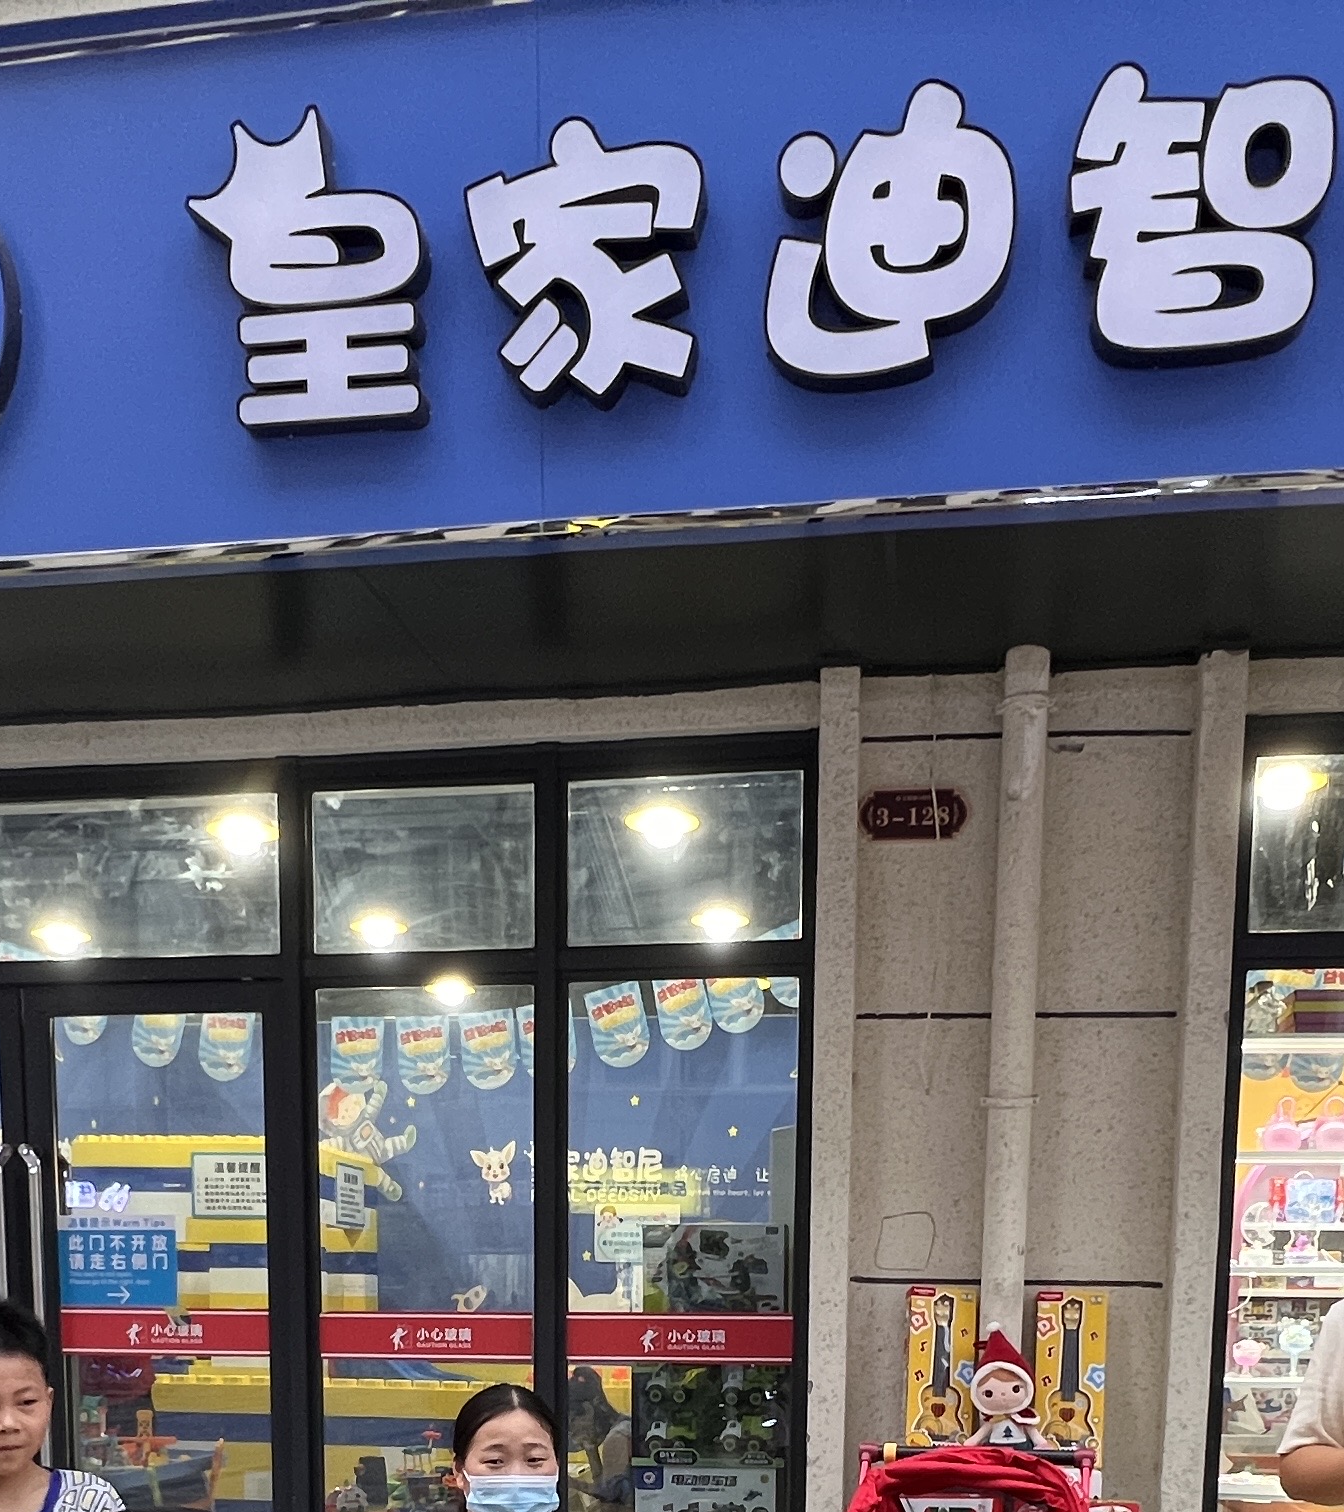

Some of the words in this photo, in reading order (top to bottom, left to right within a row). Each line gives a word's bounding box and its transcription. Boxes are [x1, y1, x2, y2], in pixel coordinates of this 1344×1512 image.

[876, 806, 950, 827] 3-128
[69, 1234, 169, 1252] 此门不开放
[69, 1253, 169, 1271] 请走右侧门
[151, 1324, 204, 1337] 小心玻璃
[416, 1327, 472, 1342] 小心玻璃
[667, 1329, 726, 1344] 小心玻璃
